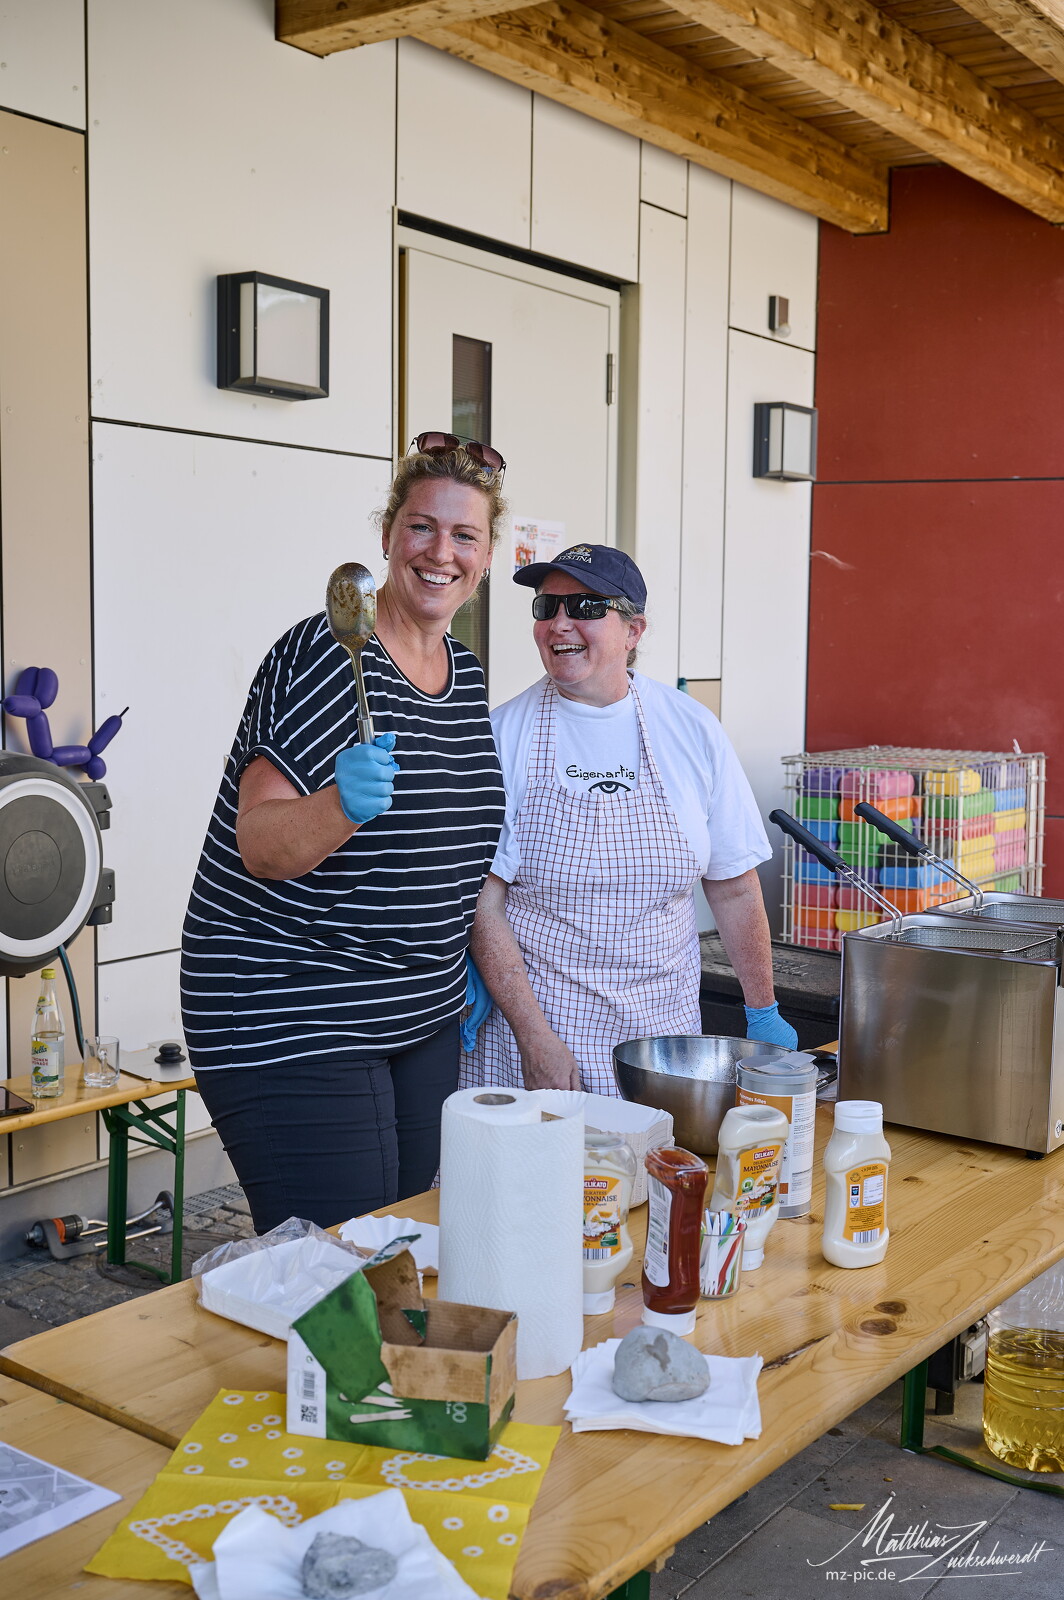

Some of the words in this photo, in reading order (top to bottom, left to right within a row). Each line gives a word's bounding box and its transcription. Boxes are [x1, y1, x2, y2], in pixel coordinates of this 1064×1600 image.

[566, 764, 635, 780] Eigenartig
[754, 1150, 774, 1159] DELIKATO
[743, 1160, 778, 1172] MAYONNAISE
